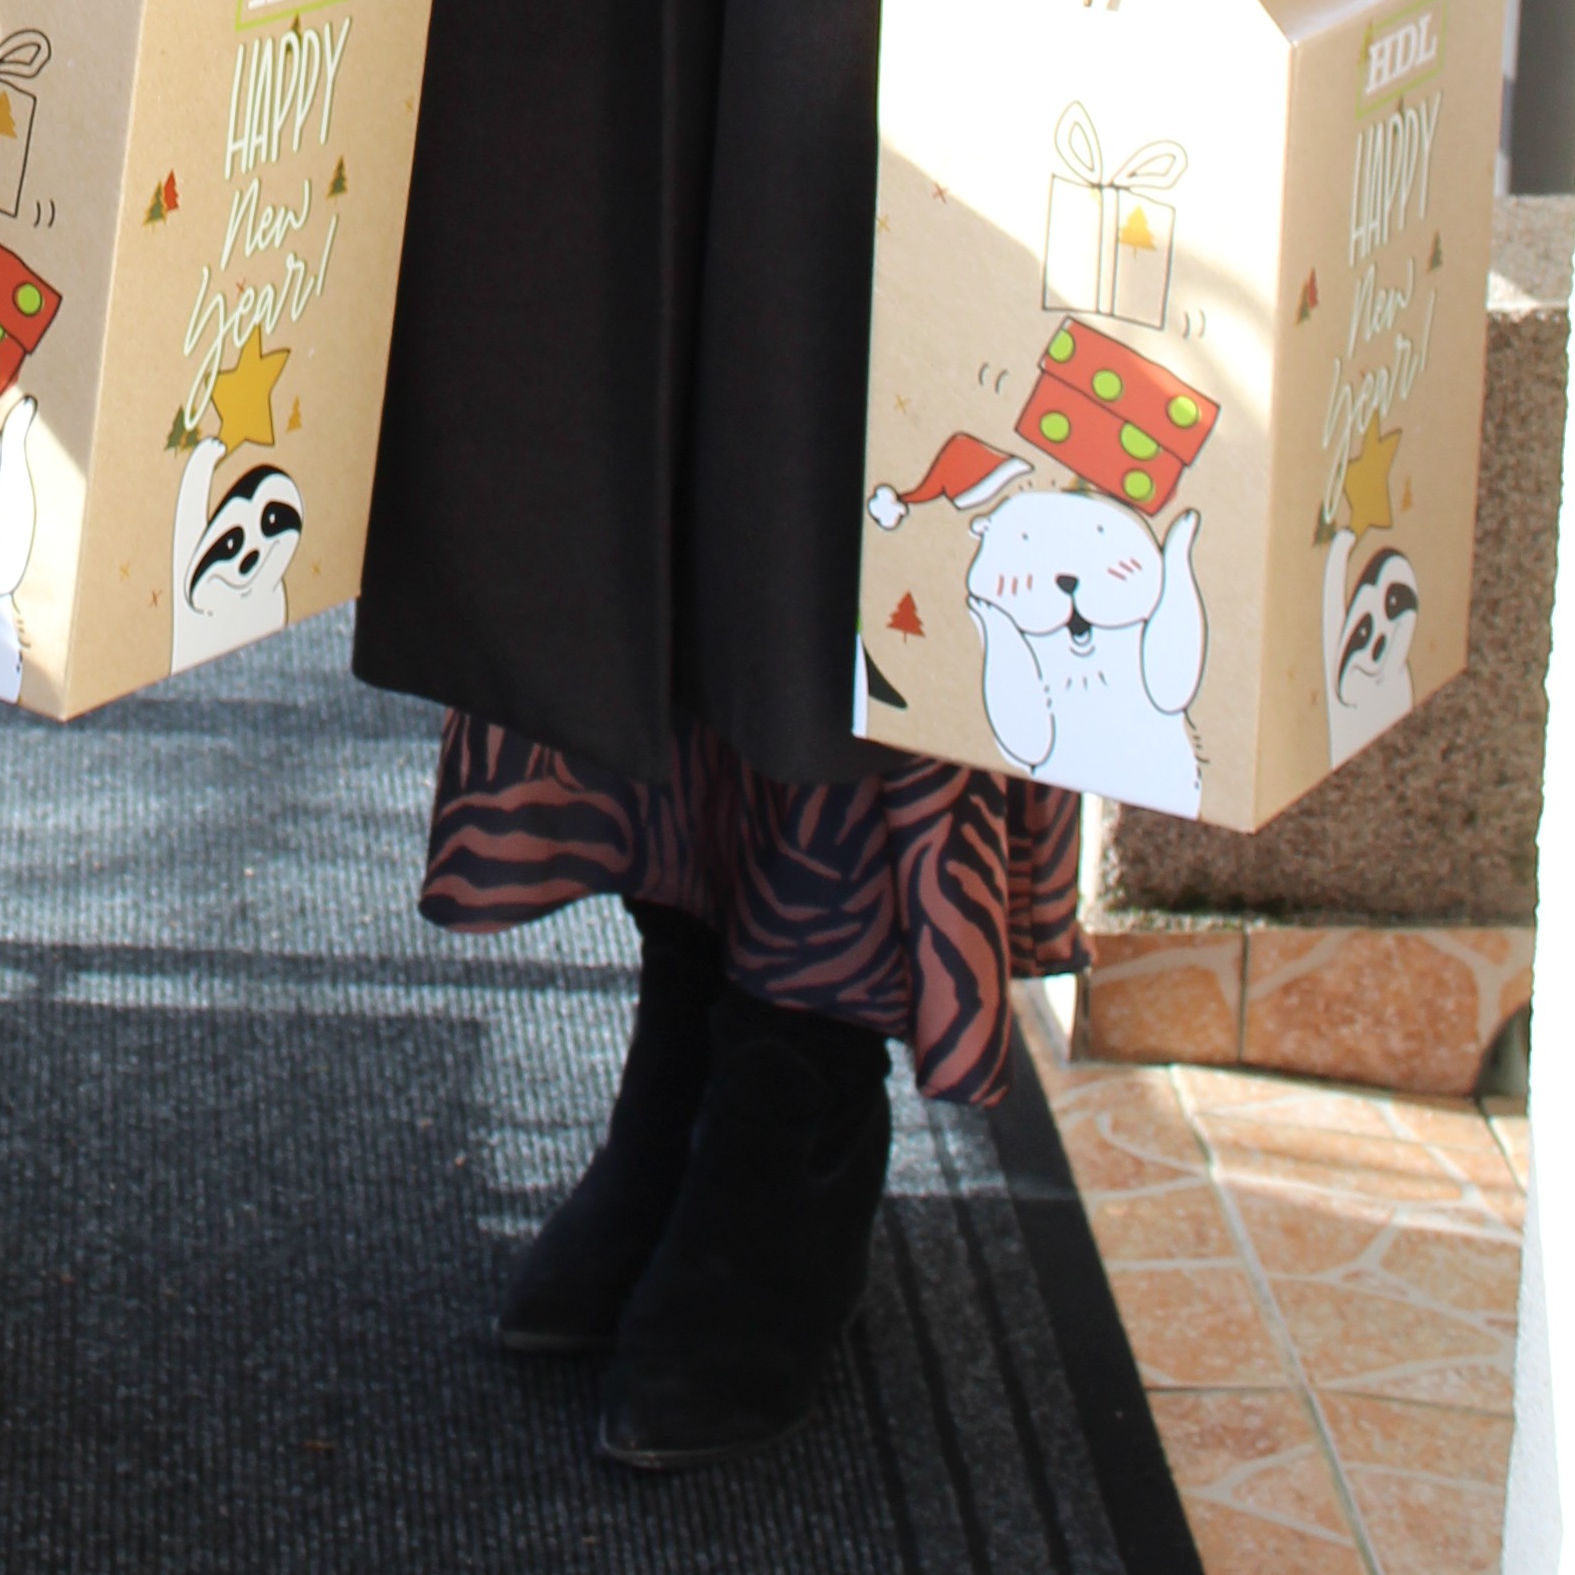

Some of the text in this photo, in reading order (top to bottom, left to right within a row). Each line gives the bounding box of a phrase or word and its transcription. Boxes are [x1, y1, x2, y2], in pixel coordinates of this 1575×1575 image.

[225, 17, 351, 180] HAPPY
[1366, 14, 1438, 95] HDL
[221, 178, 309, 270] New
[1350, 90, 1442, 266] HAPPY
[1347, 257, 1415, 358] New
